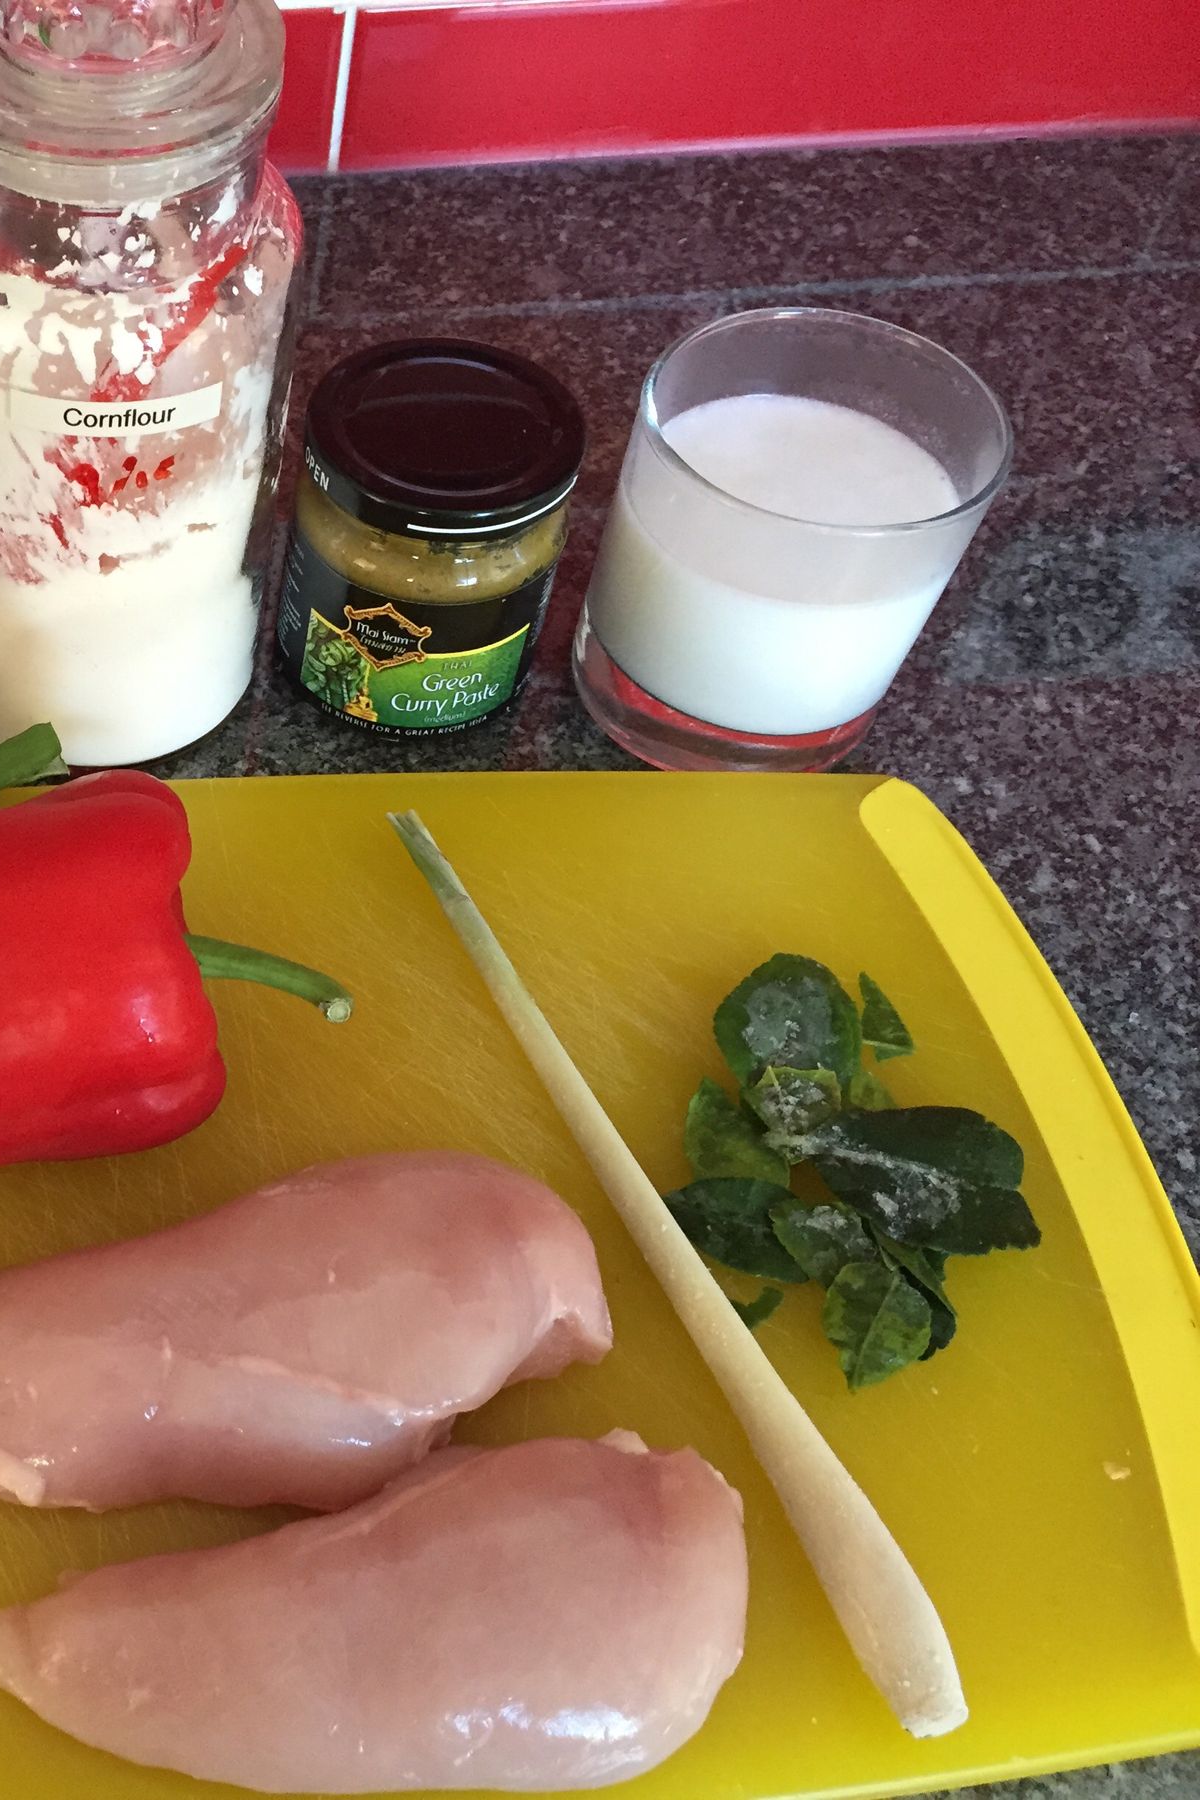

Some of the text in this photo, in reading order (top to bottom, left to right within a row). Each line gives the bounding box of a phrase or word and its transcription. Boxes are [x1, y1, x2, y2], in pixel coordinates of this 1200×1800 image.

[63, 407, 176, 428] Cornflour
[305, 446, 330, 492] OPEN
[356, 621, 380, 639] Mai
[422, 672, 483, 692] Green
[391, 683, 500, 716] Curry Paste
